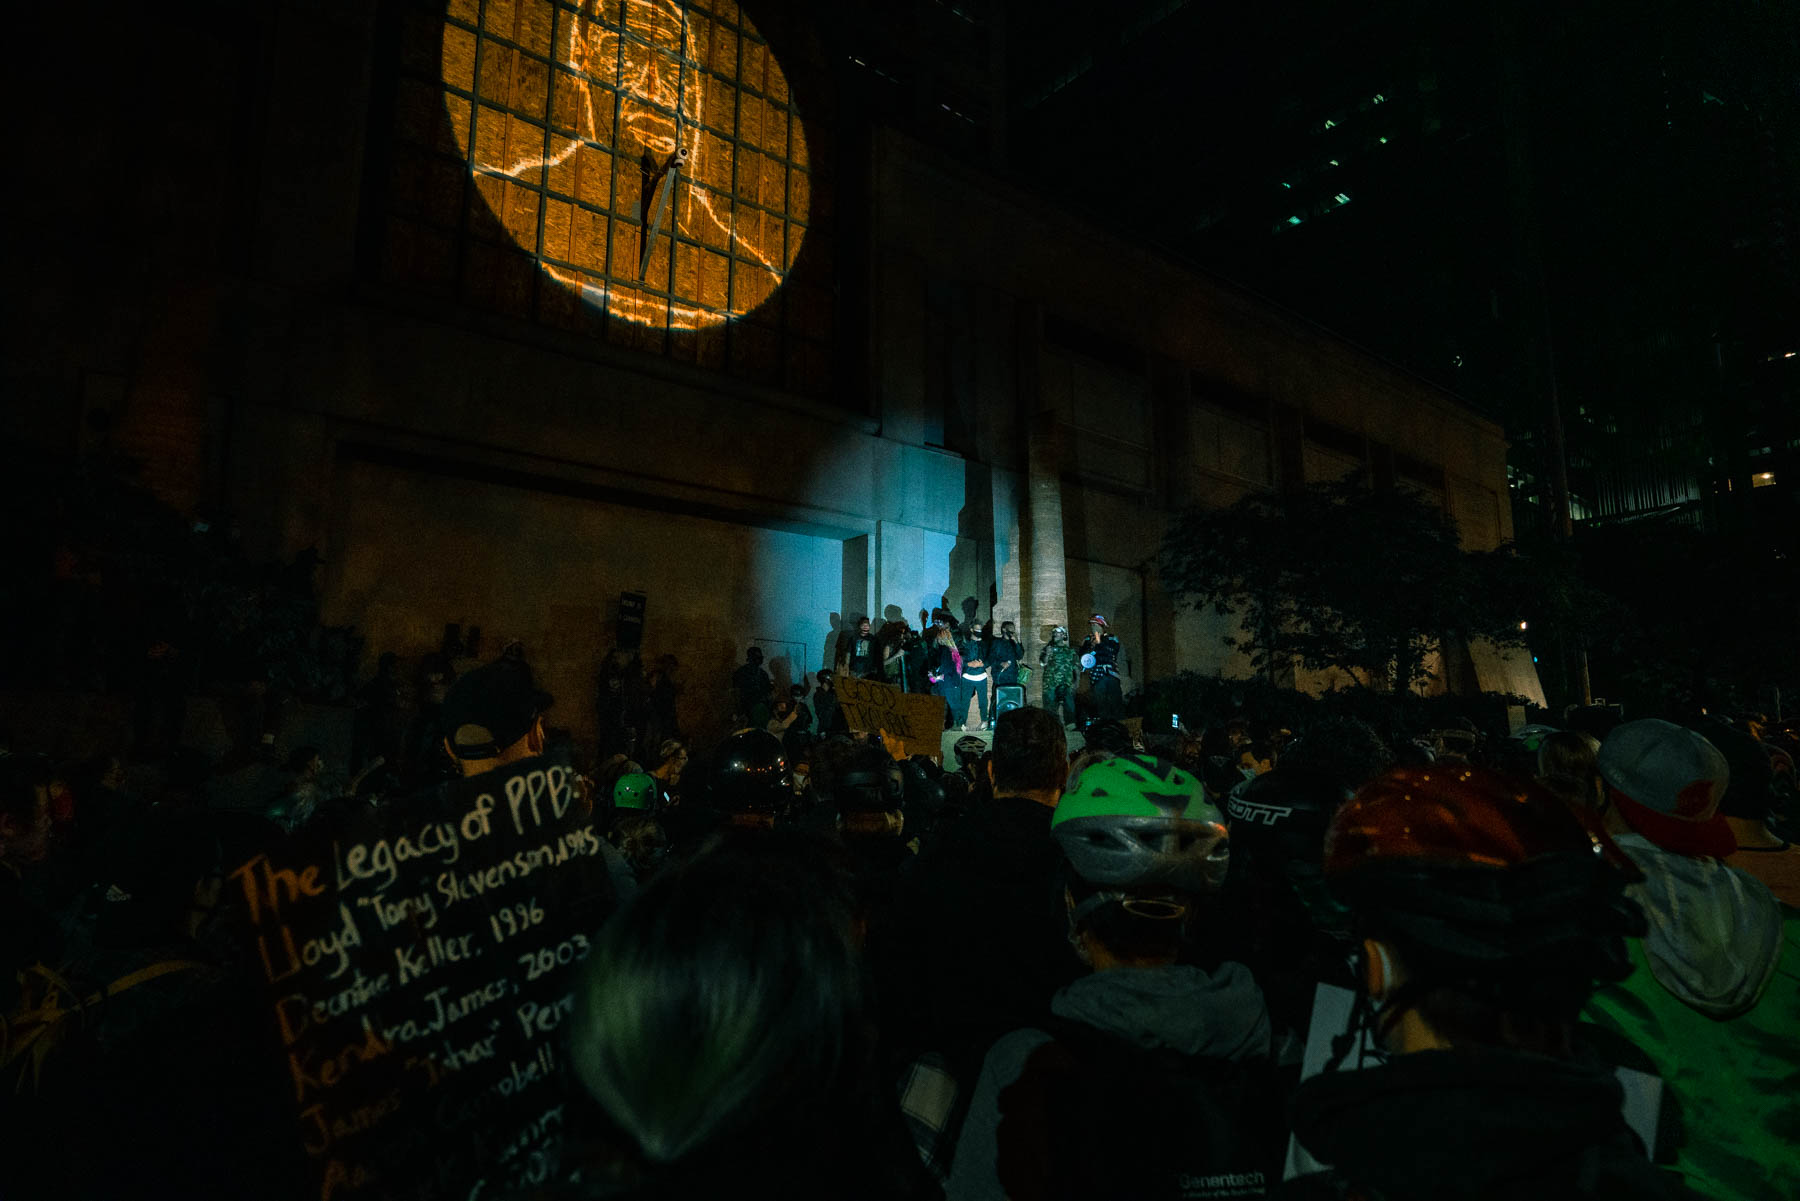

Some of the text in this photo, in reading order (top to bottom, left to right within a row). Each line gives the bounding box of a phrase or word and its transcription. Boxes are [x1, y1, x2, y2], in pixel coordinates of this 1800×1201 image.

[229, 851, 327, 928] The
[334, 823, 460, 893] Legacy
[460, 792, 496, 841] of
[490, 896, 545, 944] 1996
[517, 932, 592, 982] 2003
